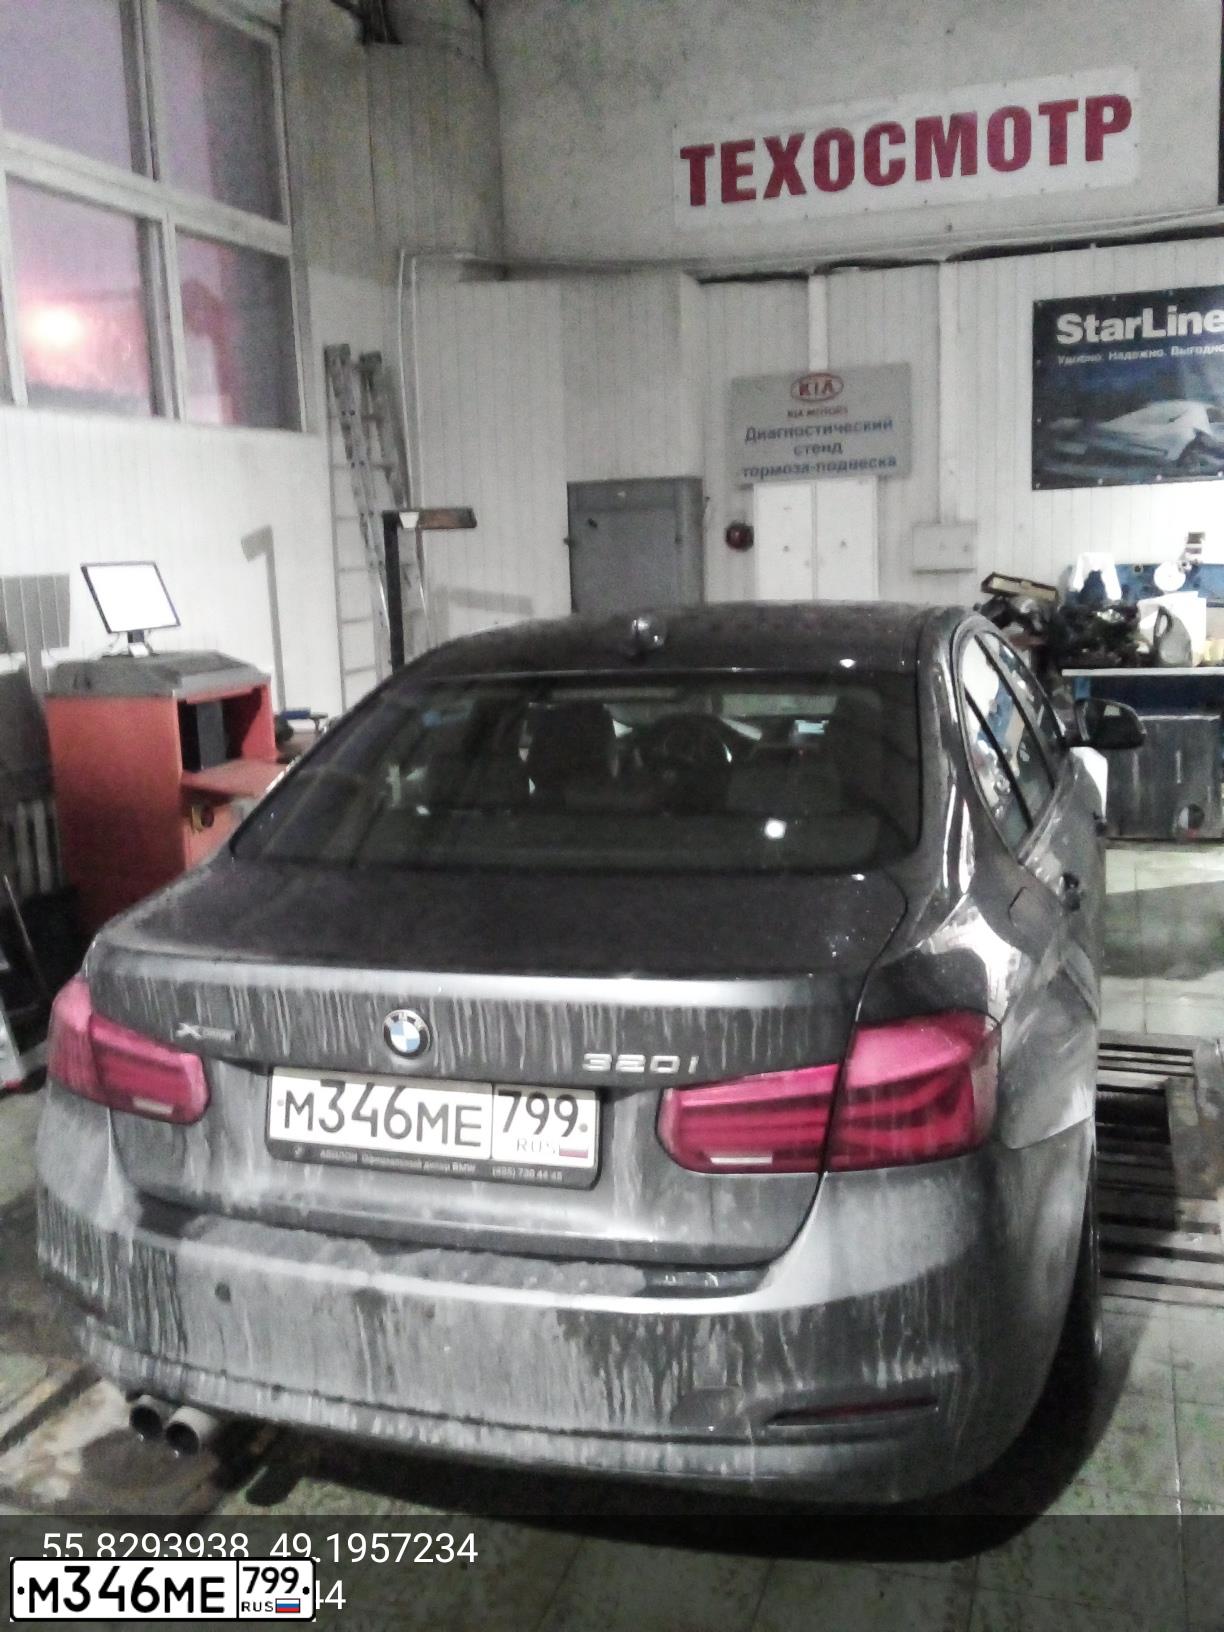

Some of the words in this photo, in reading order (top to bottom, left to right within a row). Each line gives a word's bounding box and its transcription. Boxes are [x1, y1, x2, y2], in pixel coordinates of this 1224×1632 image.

[680, 94, 1132, 207] ТЕХОСМОТР
[1056, 305, 1224, 344] StarLine
[799, 379, 833, 397] KIA
[744, 419, 894, 443] Диагностический
[794, 442, 844, 456] стенд
[498, 1089, 579, 1138] 799
